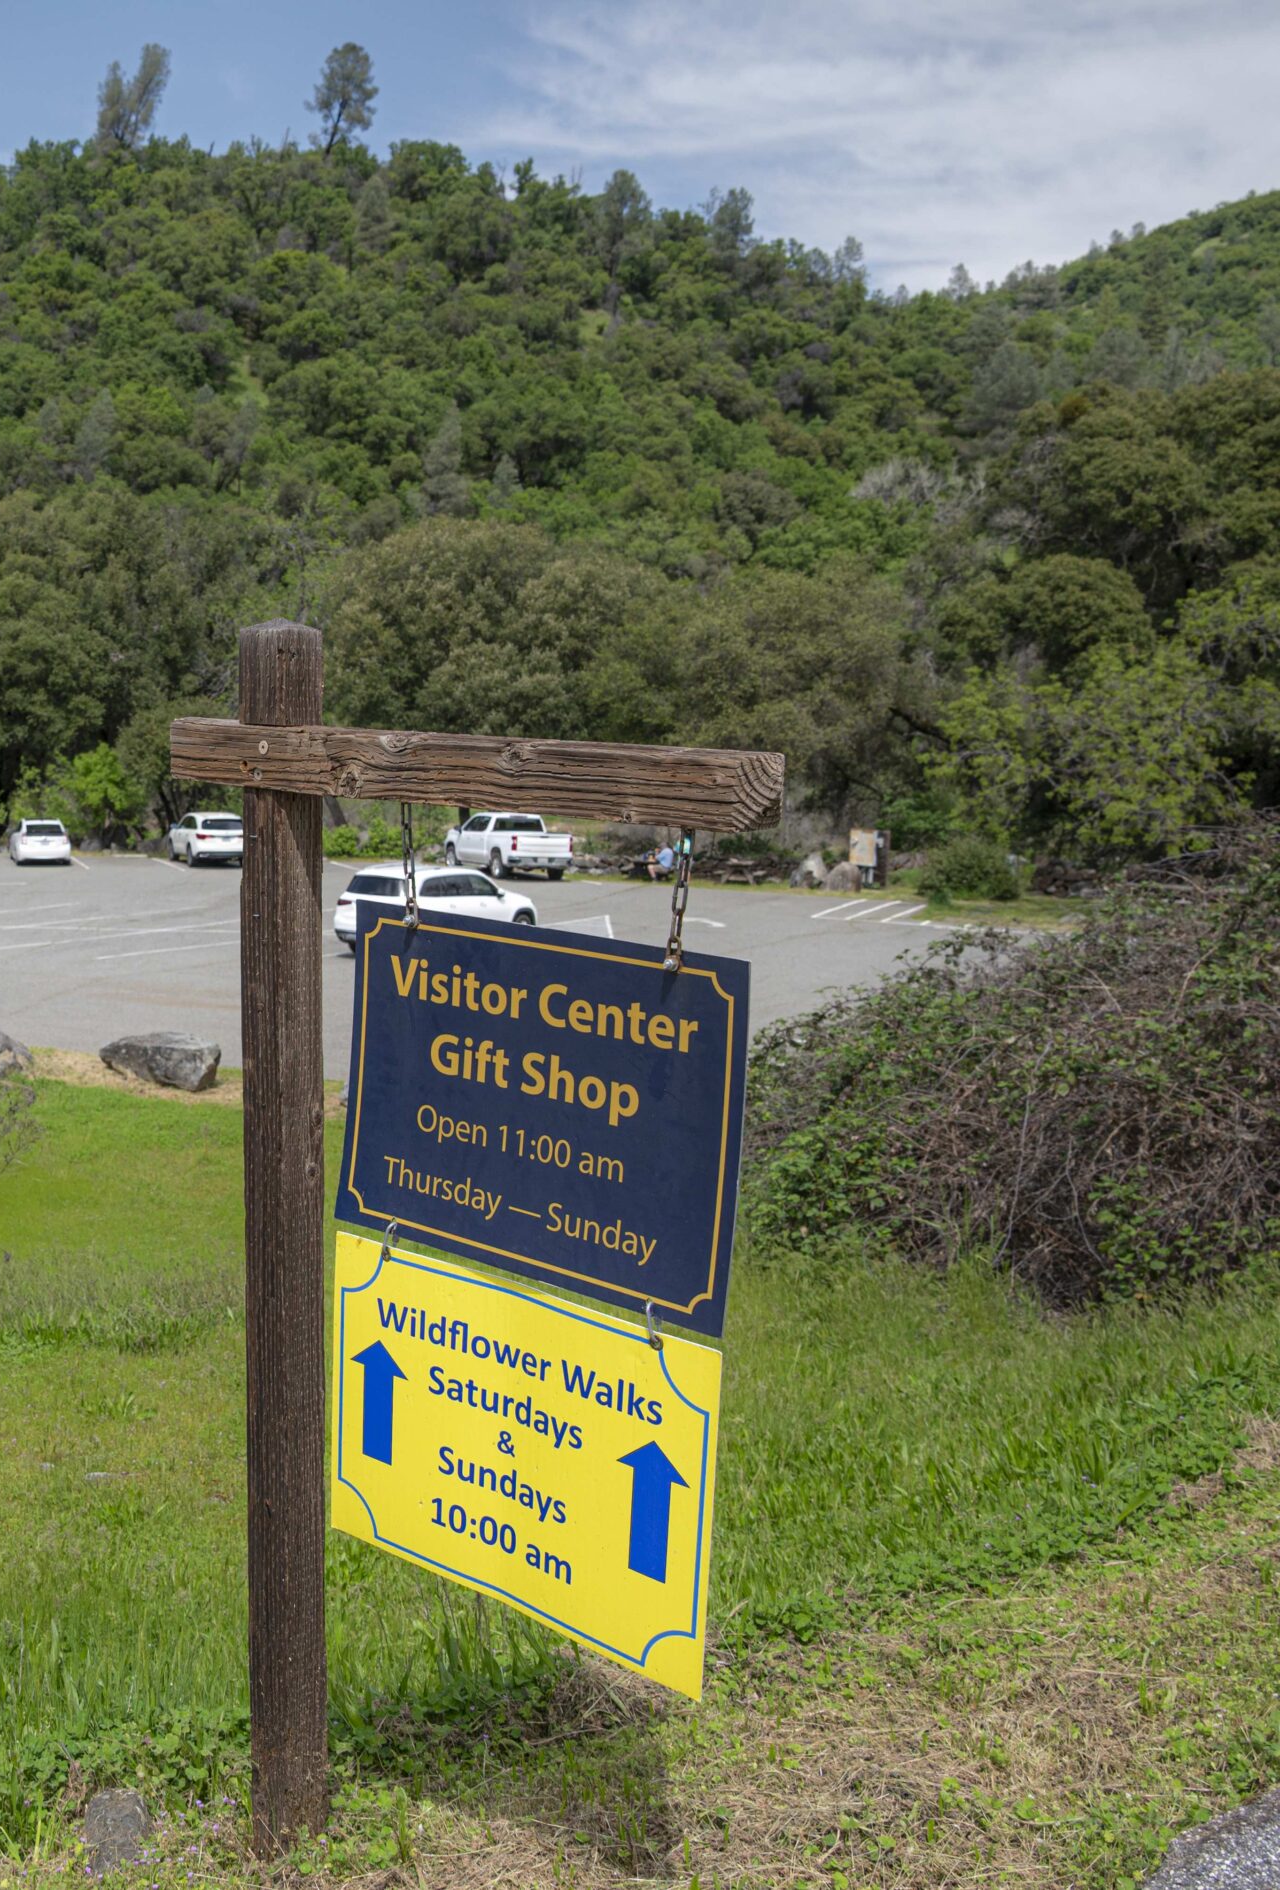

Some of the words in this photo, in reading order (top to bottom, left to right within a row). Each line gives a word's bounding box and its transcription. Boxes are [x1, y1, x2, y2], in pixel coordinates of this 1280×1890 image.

[391, 955, 527, 1019] Visitor
[538, 983, 698, 1053] Center
[430, 1033, 509, 1088] Gift
[521, 1052, 639, 1126] Shop
[417, 1105, 487, 1147] Open
[499, 1124, 571, 1168] 11:00
[579, 1152, 624, 1183] am
[384, 1156, 502, 1220] Thursday
[546, 1203, 657, 1266] Sunday
[377, 1298, 552, 1382] Wildflower
[562, 1360, 663, 1426] Walks
[428, 1366, 583, 1450] Saturdays
[497, 1430, 515, 1457] &
[438, 1447, 567, 1524] Sundays
[431, 1498, 516, 1555] 10:00
[525, 1544, 572, 1585] am
